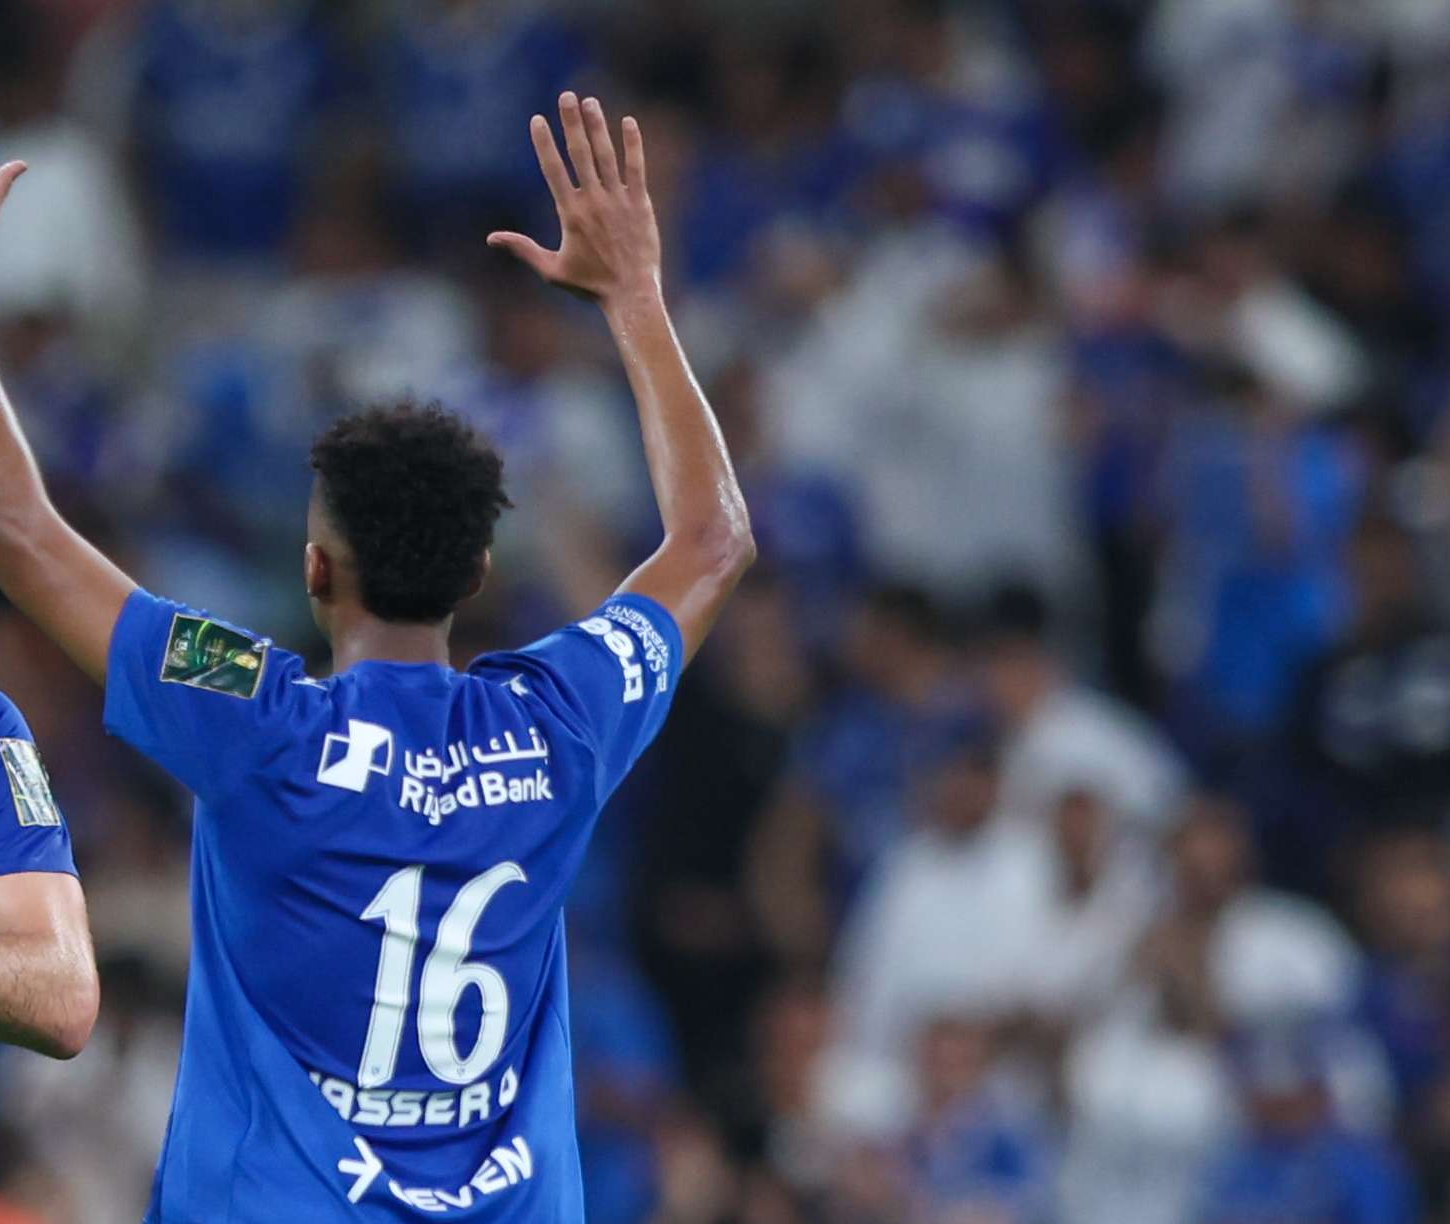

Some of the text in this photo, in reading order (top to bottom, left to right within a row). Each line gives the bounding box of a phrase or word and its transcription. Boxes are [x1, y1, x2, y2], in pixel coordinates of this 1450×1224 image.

[479, 769, 553, 807] Bank
[359, 860, 528, 1090] 16
[309, 1071, 491, 1128] ASSER
